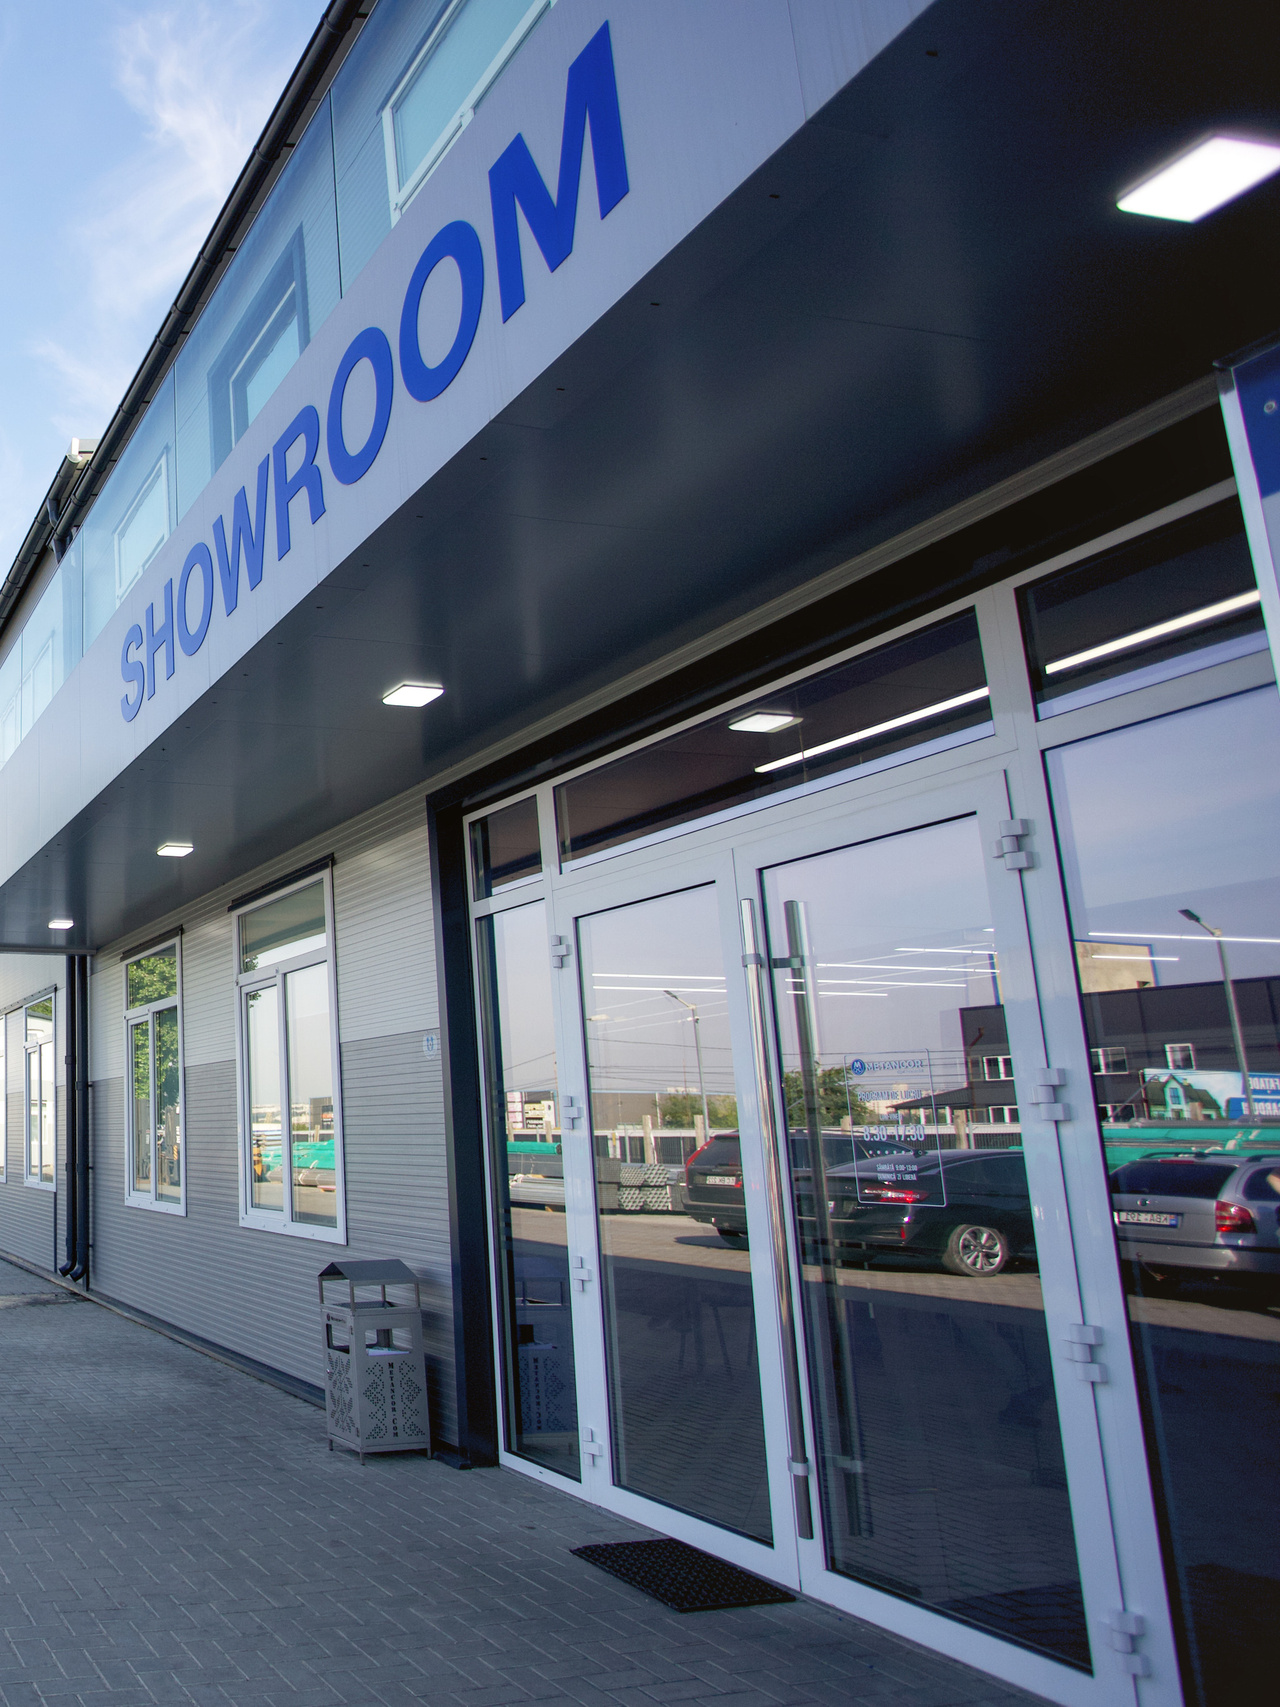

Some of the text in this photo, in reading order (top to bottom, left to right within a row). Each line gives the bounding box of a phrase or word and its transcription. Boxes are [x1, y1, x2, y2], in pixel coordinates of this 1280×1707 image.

[120, 20, 630, 722] SHOWROOM
[865, 1060, 924, 1071] METANCOR
[857, 1089, 922, 1102] PROGRAM DE LUCRU
